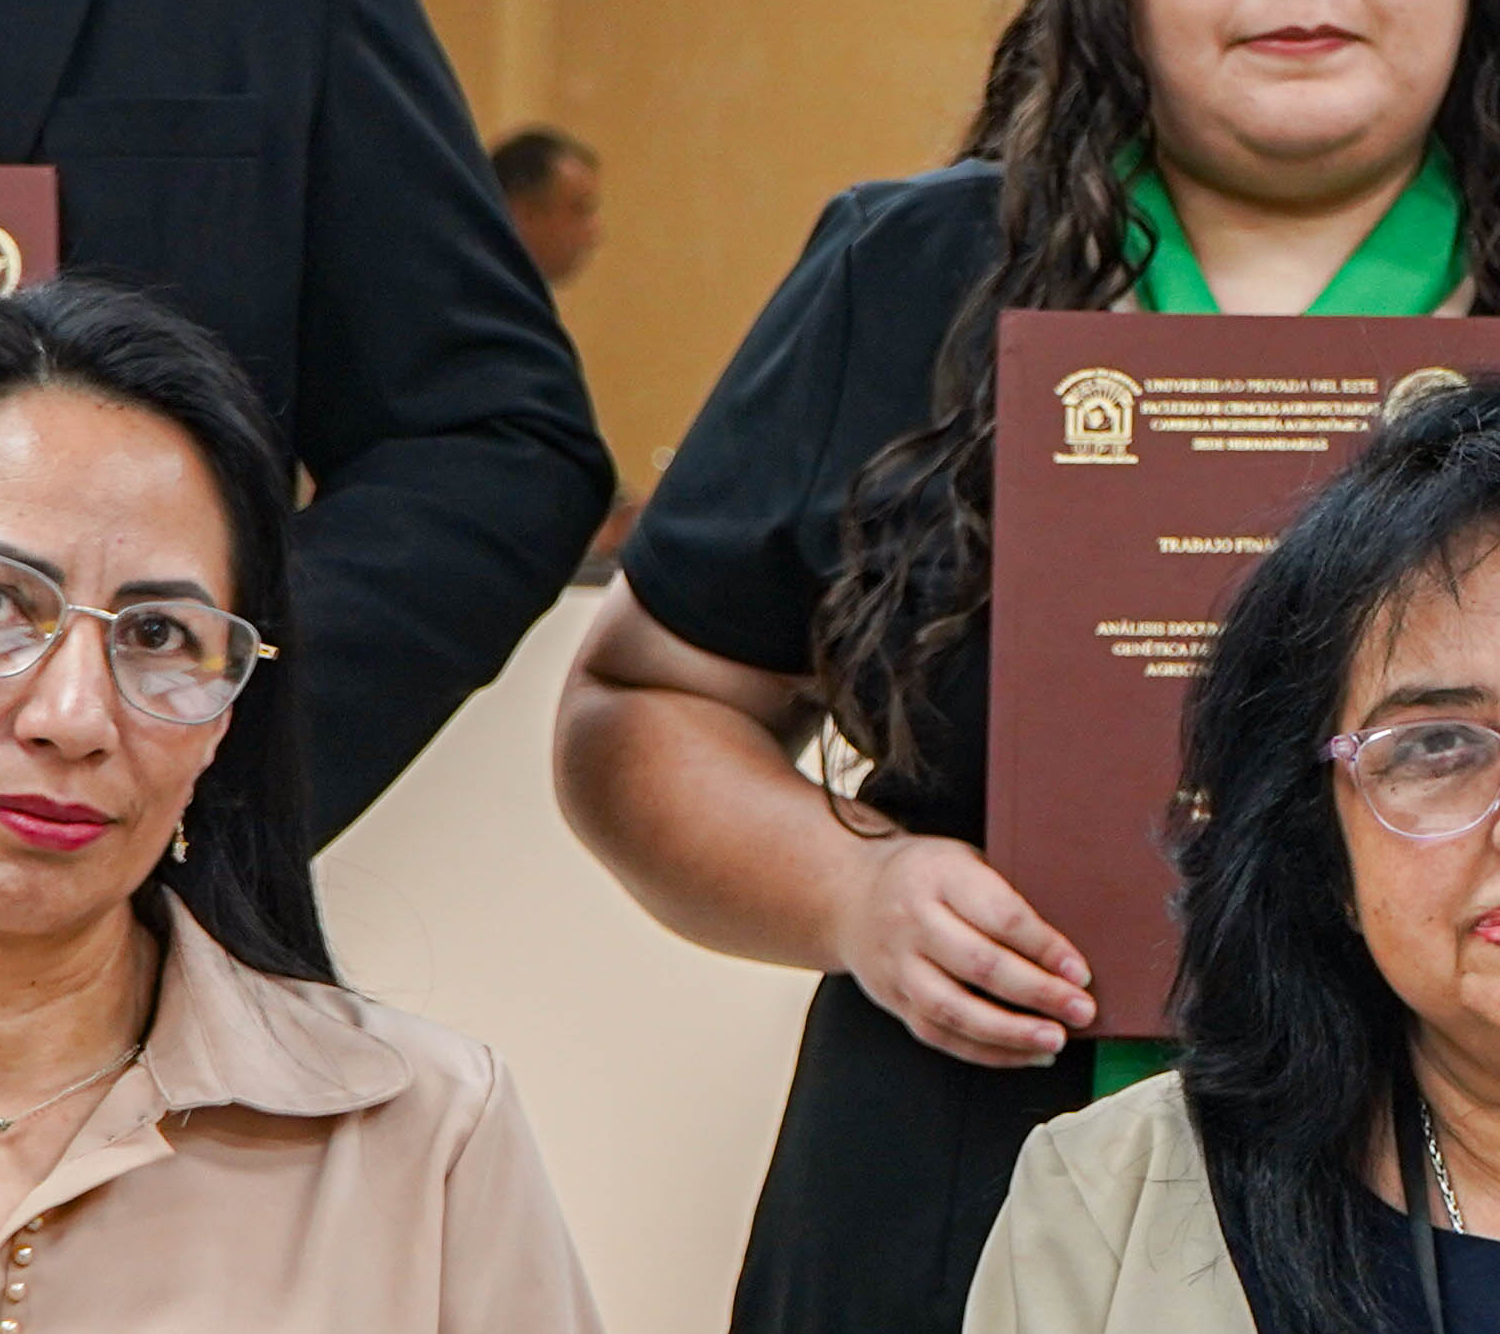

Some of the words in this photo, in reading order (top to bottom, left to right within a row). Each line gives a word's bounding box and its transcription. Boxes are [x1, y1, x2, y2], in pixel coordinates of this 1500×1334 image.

[1143, 378, 1245, 393] UNIVERSIDAD
[1246, 378, 1309, 393] PRIVADA
[1310, 378, 1340, 393] DEL
[1341, 378, 1379, 393] ESTE
[1157, 536, 1234, 554] TRABAJO
[1235, 536, 1281, 553] FINA
[1094, 618, 1167, 637] ANÁLISIS
